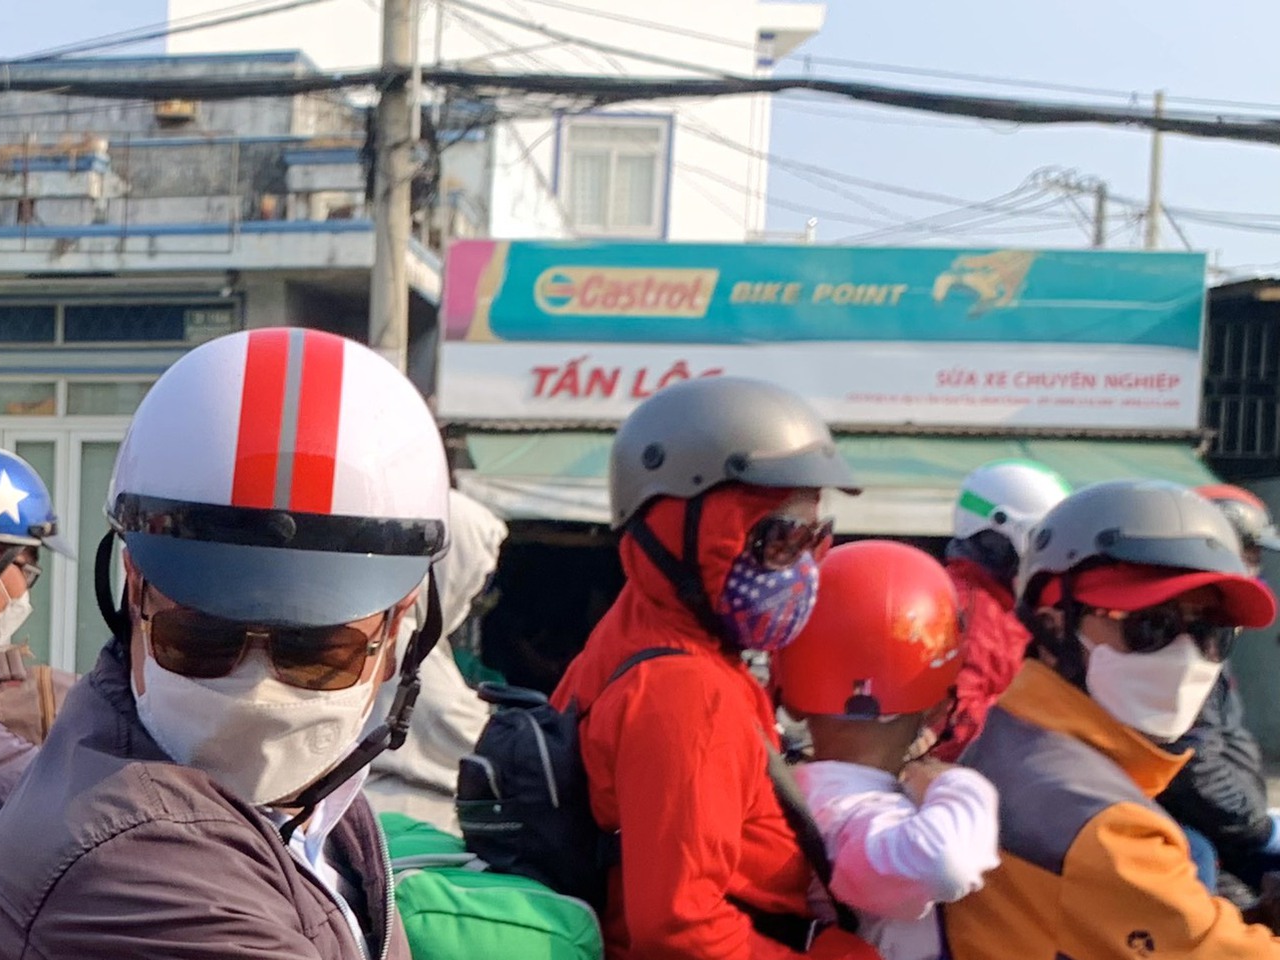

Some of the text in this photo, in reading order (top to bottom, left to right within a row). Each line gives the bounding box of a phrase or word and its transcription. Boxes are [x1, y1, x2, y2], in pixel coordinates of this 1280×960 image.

[575, 274, 908, 311] Castrol BIKE POINT
[532, 354, 621, 398] TẤN
[983, 372, 1008, 388] XE
